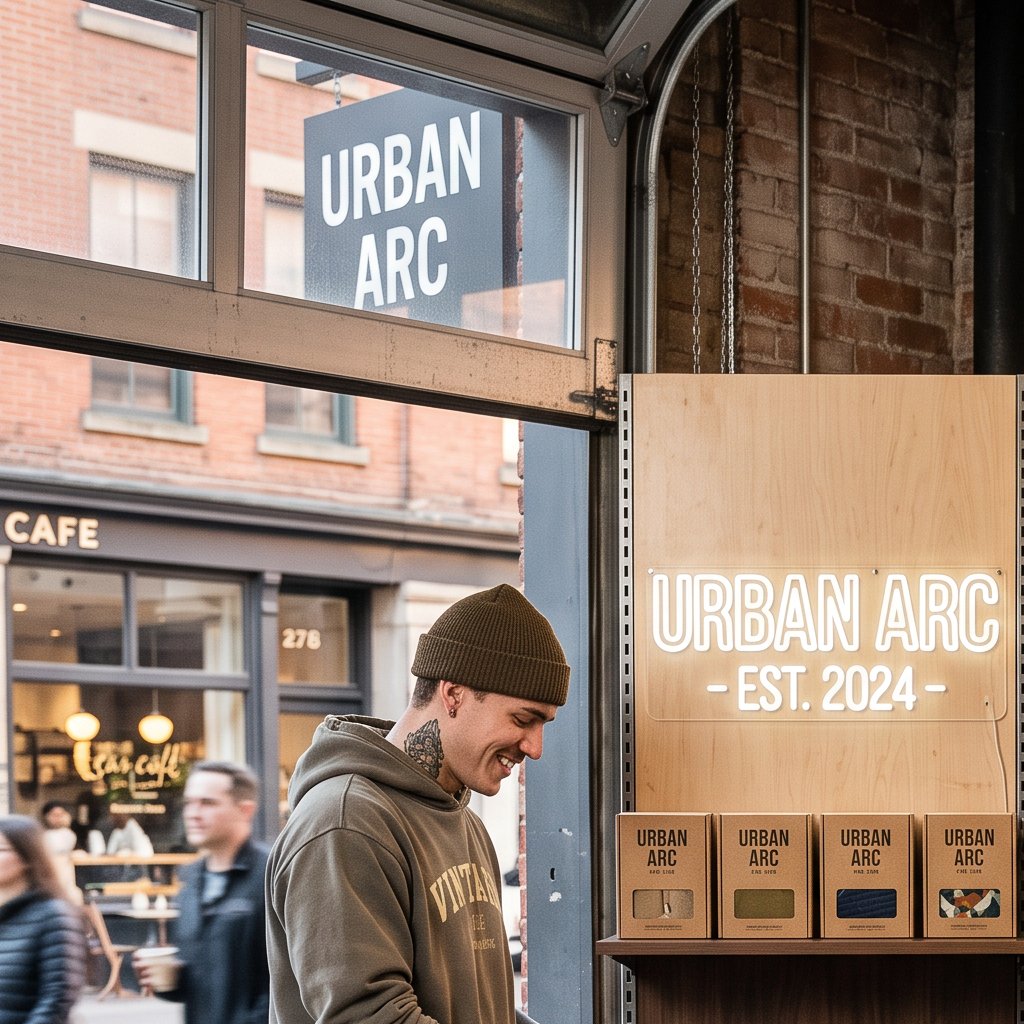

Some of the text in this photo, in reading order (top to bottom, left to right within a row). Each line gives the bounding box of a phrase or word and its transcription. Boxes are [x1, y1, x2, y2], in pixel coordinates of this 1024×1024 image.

[321, 110, 481, 227] URBAN
[353, 216, 448, 310] ARC
[4, 511, 99, 549] CAFE
[652, 573, 1000, 653] URBAN ARC
[822, 665, 917, 711] 2024
[637, 829, 687, 847] URBAN
[739, 829, 789, 847] URBAN
[841, 829, 891, 847] URBAN
[944, 828, 994, 846] URBAN
[647, 849, 677, 866] ARC
[749, 849, 779, 866] ARC
[851, 849, 881, 866] ARC
[954, 849, 984, 866] ARC
